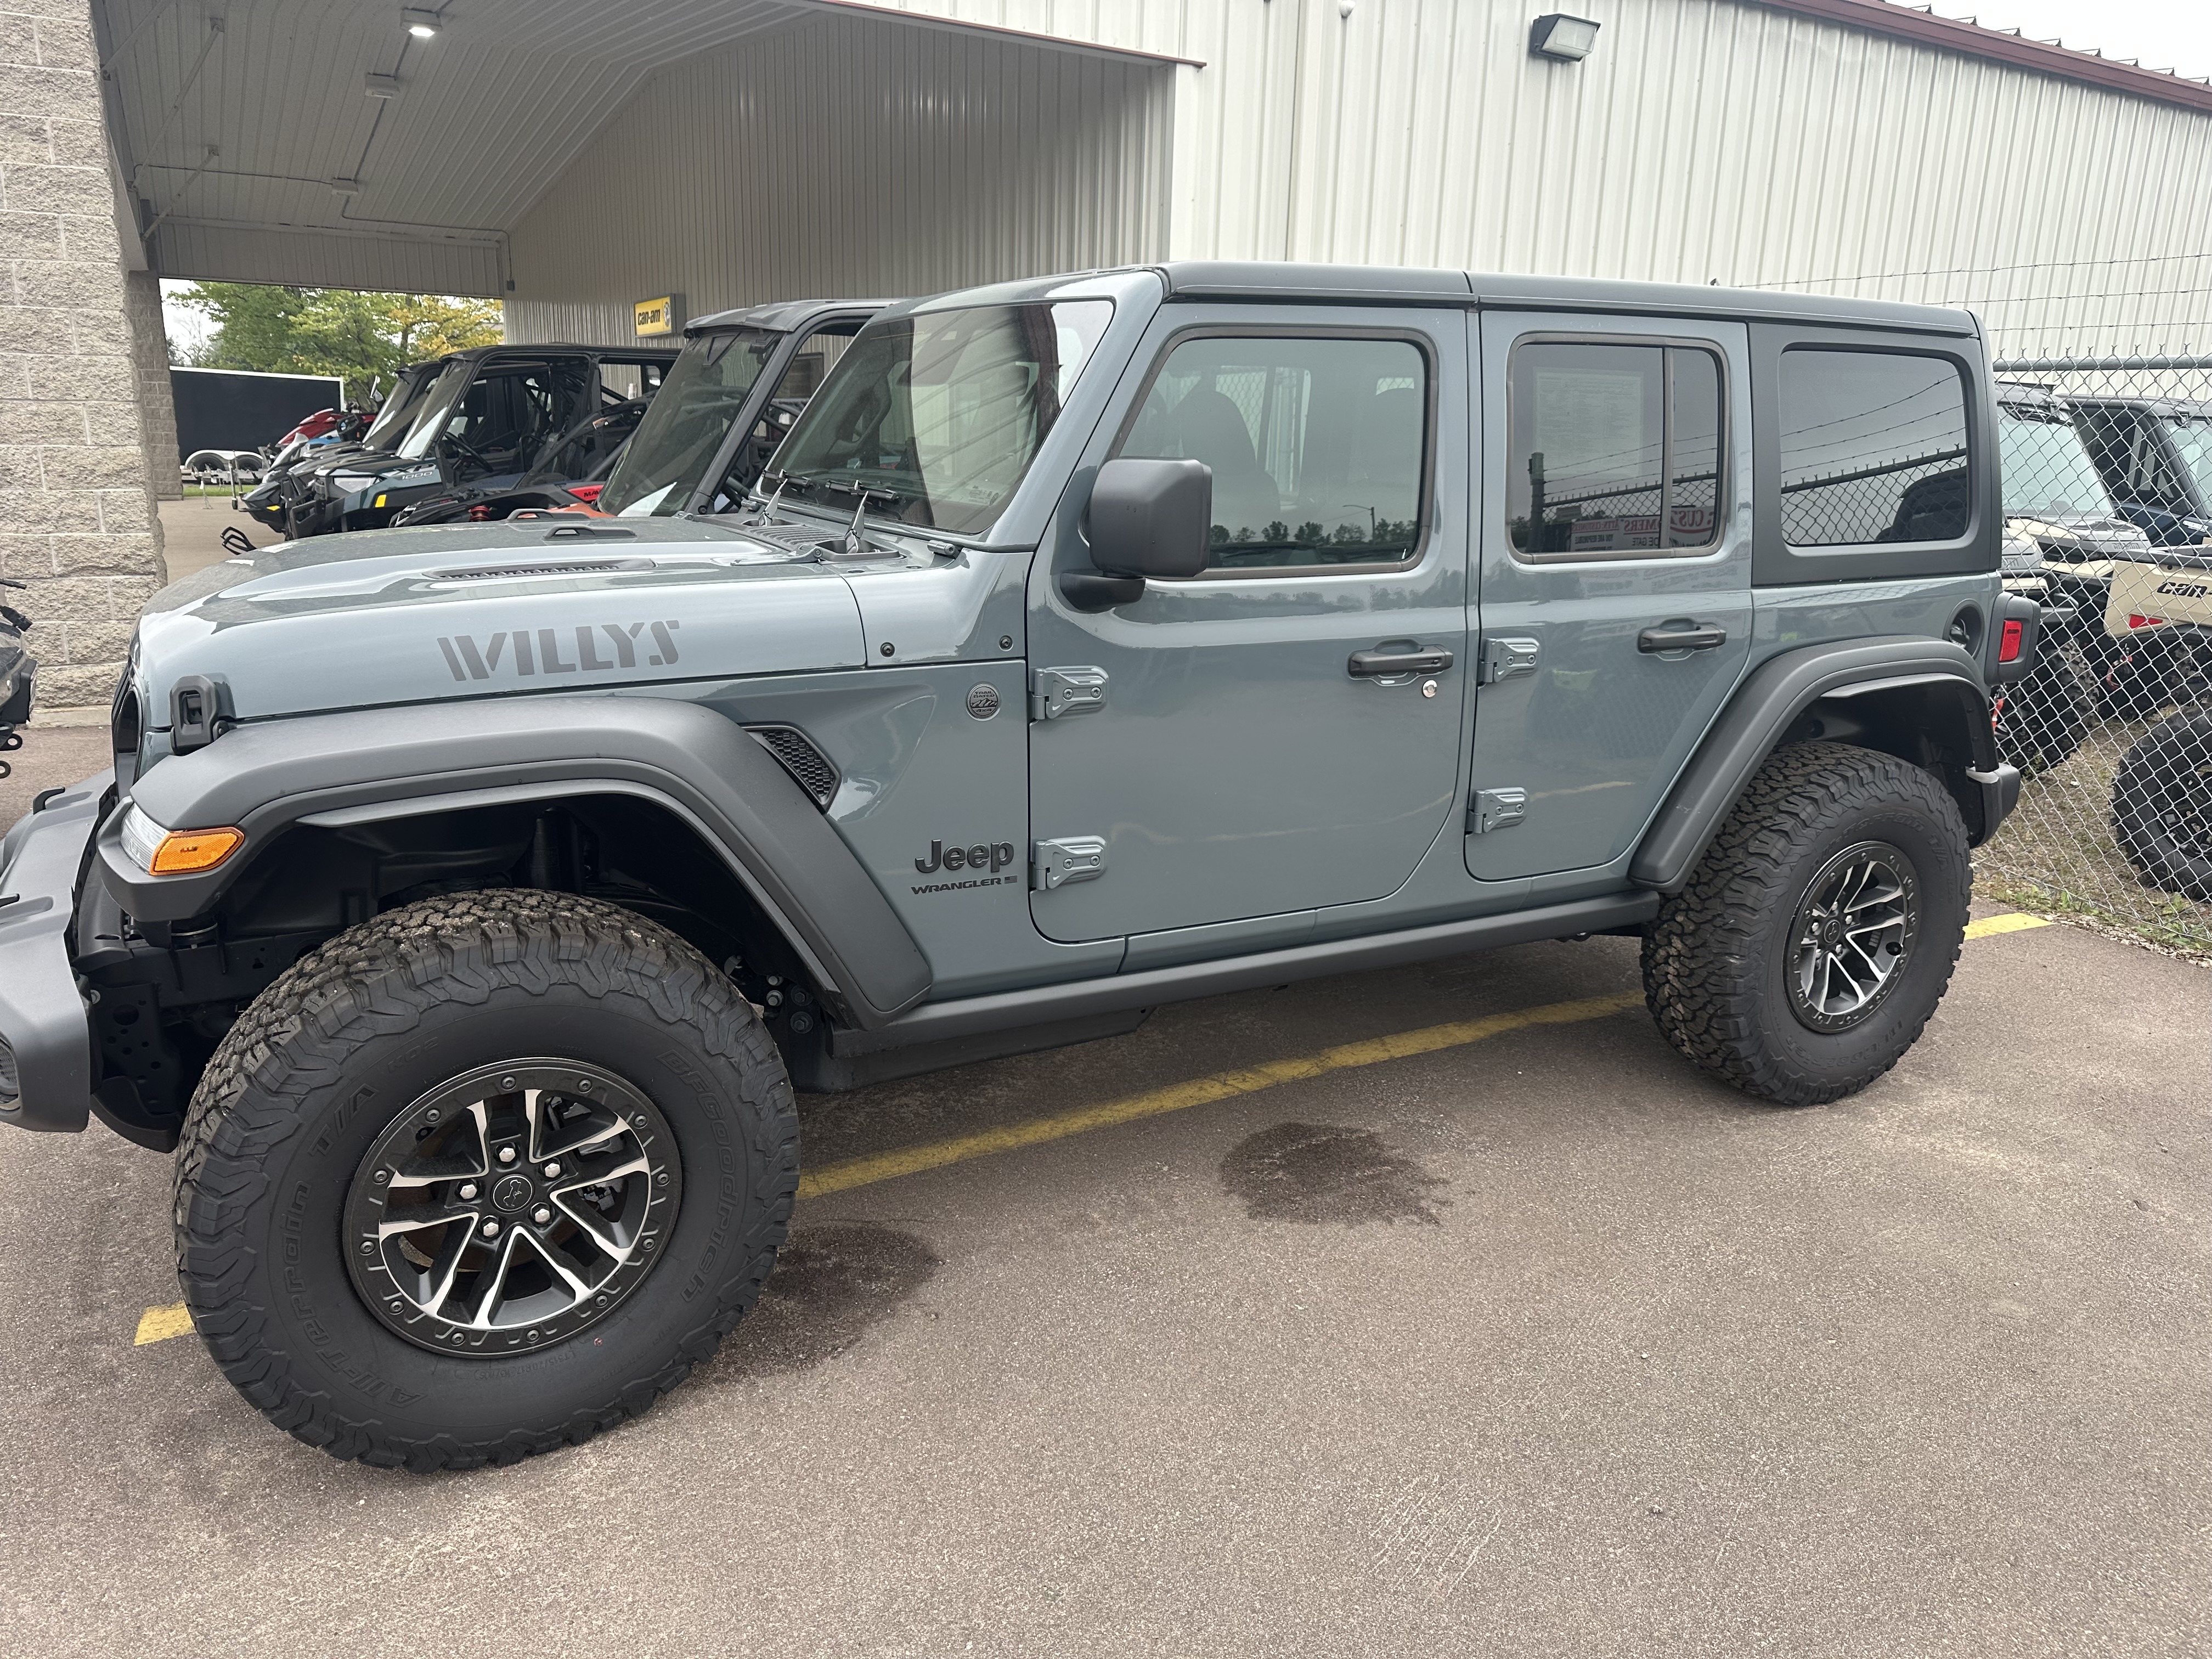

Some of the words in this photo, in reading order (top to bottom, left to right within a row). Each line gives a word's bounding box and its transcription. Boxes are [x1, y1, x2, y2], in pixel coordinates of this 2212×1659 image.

[637, 308, 661, 325] can-am
[437, 620, 680, 681] WILLYS
[915, 839, 1014, 873] Jeep
[911, 877, 1002, 895] WRANGLER
